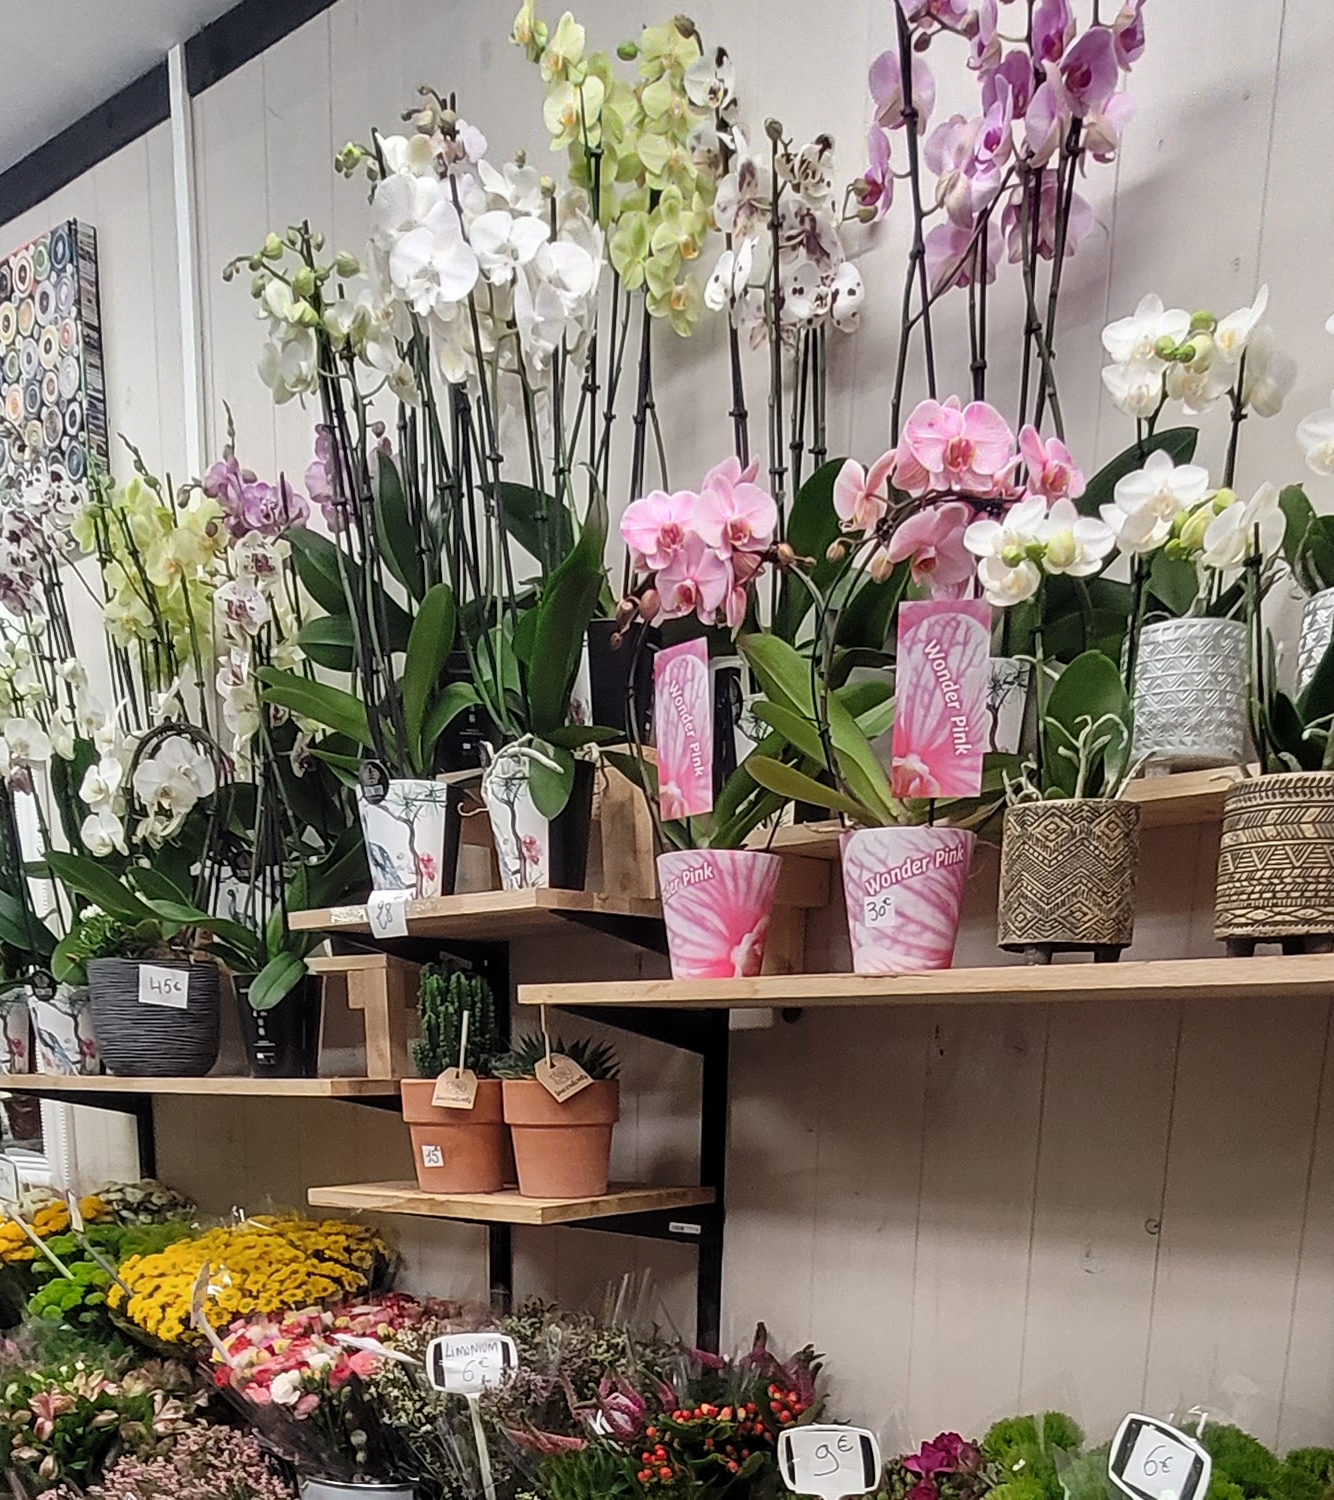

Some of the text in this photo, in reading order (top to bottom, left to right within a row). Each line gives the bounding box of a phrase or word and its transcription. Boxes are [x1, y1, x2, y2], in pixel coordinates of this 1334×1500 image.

[923, 638, 973, 756] Wonder Pink
[668, 679, 705, 777] Wonder Pink
[682, 861, 714, 887] Pink
[864, 843, 965, 896] Wonder Pink
[813, 1433, 854, 1477] 9€
[1143, 1444, 1175, 1477] 6€
